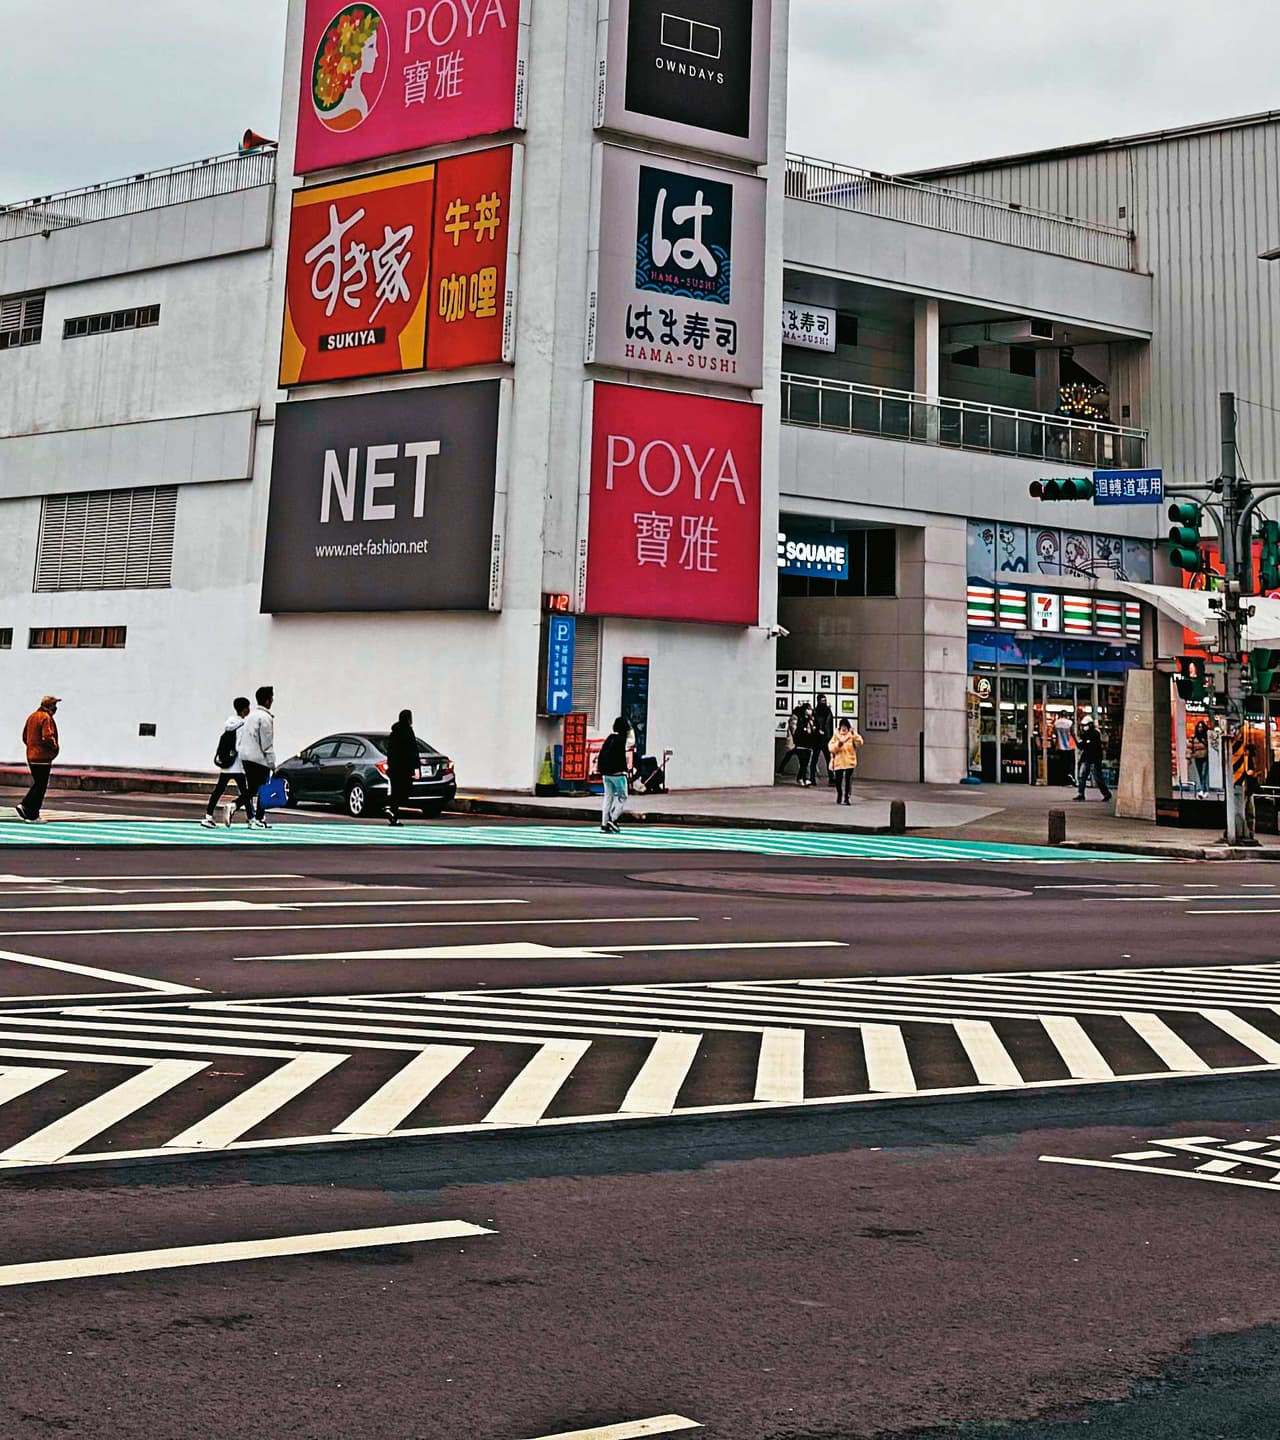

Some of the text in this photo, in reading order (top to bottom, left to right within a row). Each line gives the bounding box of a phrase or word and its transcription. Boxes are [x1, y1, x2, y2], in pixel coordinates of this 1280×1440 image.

[403, 50, 465, 108] 寶雅
[655, 57, 725, 85] OWNDAYS
[443, 192, 502, 247] 牛丼
[650, 186, 718, 277] は
[304, 204, 414, 324] すき家
[650, 271, 717, 291] HAMA-SUSHI
[439, 266, 498, 324] 咖哩
[327, 330, 377, 350] SUKIYA
[625, 303, 738, 357] はま寿司
[783, 331, 829, 346] MA-SUSHI
[625, 343, 738, 375] HAMA-SUSHI
[320, 439, 441, 524] NET
[605, 435, 747, 506] POYA
[1095, 477, 1161, 497] 迴轉道專用
[315, 538, 428, 559] www.net-fashion.net
[633, 509, 720, 574] 寶雅
[786, 541, 845, 564] SQUARE
[558, 623, 568, 641] P
